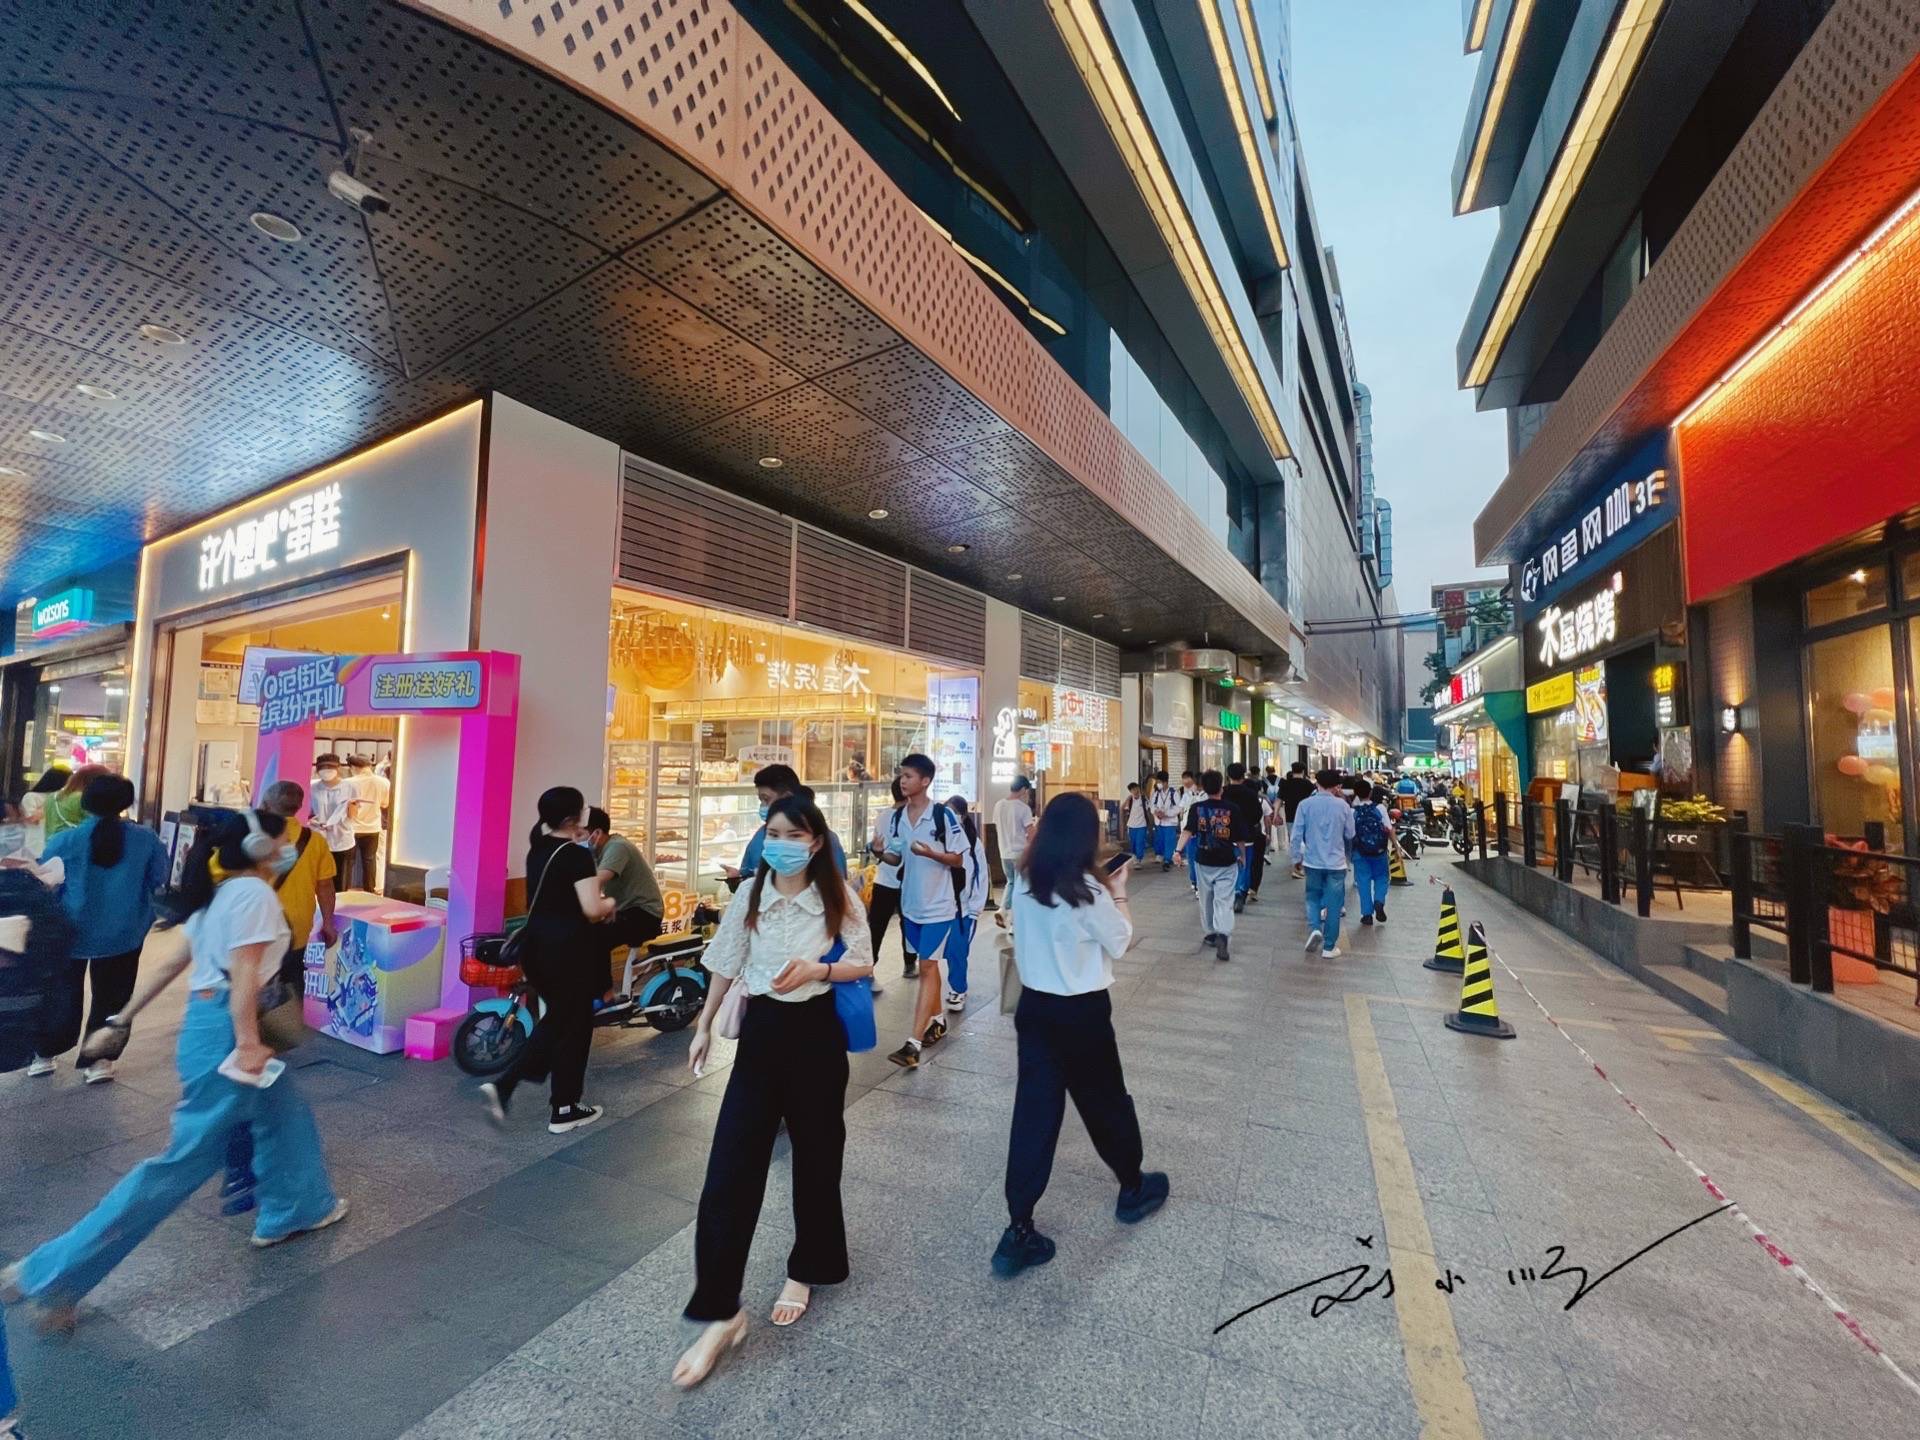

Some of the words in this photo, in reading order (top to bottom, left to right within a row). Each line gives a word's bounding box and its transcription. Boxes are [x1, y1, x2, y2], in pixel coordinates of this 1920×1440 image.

[1542, 481, 1631, 586] 网鱼网咖
[1635, 469, 1665, 514] 3F
[37, 600, 70, 626] watsons
[1538, 589, 1616, 668] 木屋烧烤
[260, 683, 345, 730] 缤纷开业
[375, 671, 476, 699] 注册送好礼
